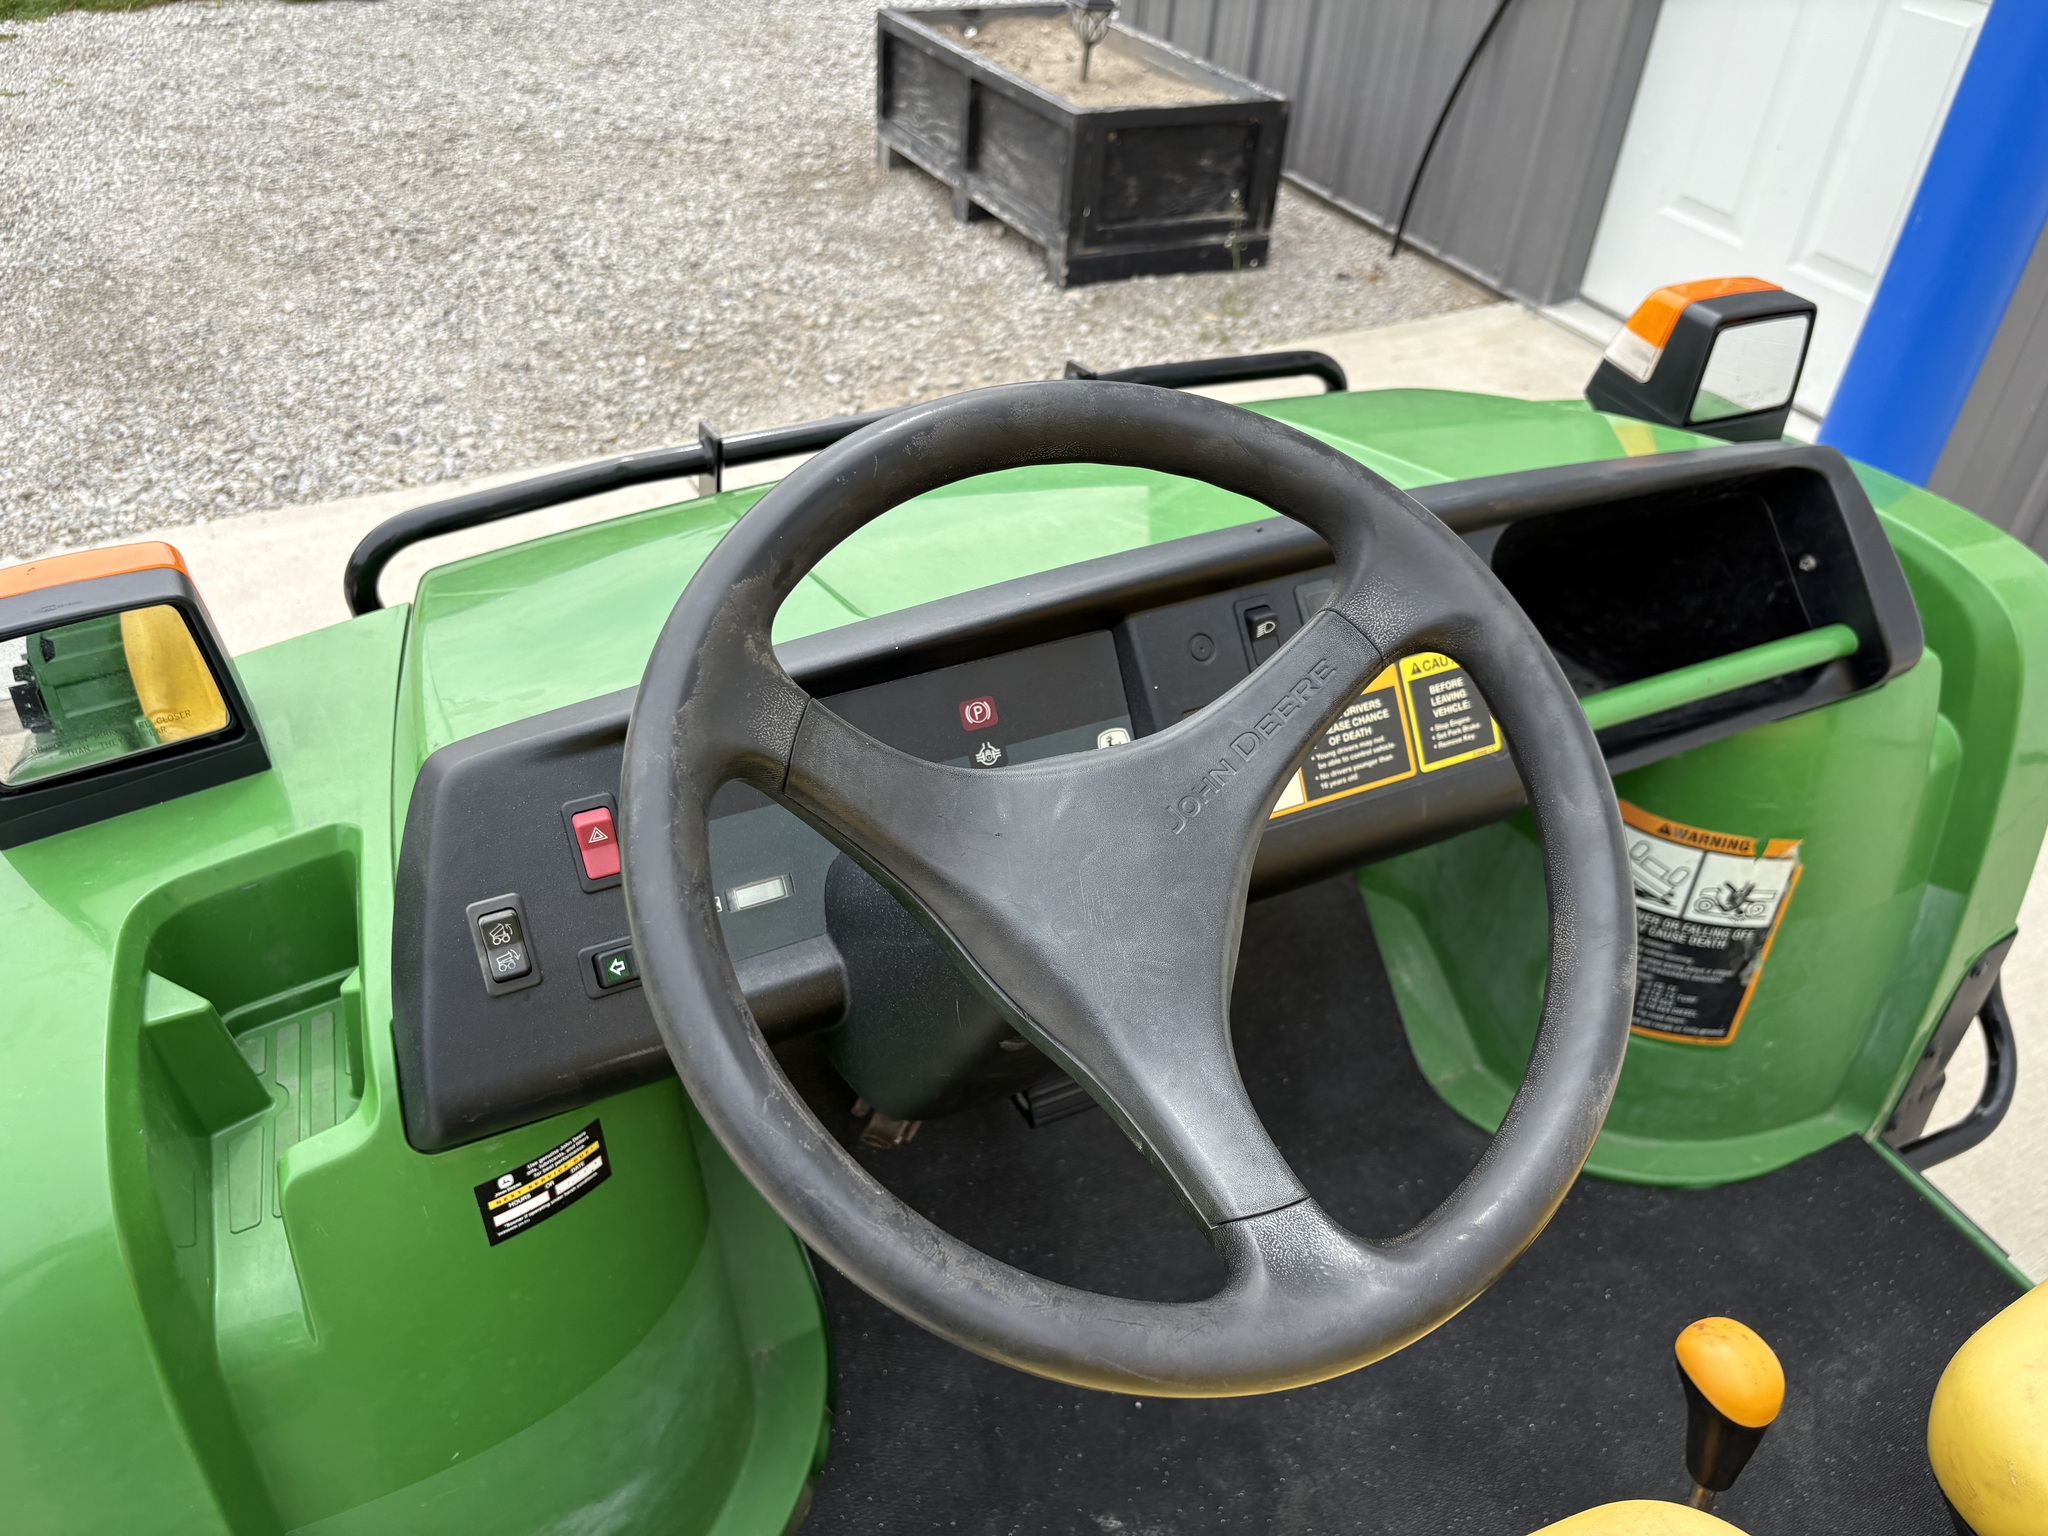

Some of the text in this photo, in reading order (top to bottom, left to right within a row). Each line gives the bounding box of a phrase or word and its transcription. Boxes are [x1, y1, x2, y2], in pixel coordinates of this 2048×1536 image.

[1428, 676, 1465, 695] BEFORE
[1343, 698, 1382, 717] DRIVERS
[1429, 688, 1468, 707] LEAVING
[1431, 699, 1472, 718] VEHICLE:
[156, 709, 192, 725] CLOSER
[1326, 708, 1390, 734] EASE CHANCE
[1434, 721, 1450, 732] Stop
[1328, 726, 1373, 746] OF DEATH
[1436, 722, 1481, 740] Set Park Brake
[67, 744, 91, 758] THAN
[99, 736, 124, 749] THEY
[1166, 658, 1337, 835] JOHN DEERE
[1316, 735, 1385, 761] Young drivers may not
[1438, 738, 1463, 750] Remove
[1318, 762, 1328, 770] be
[1328, 758, 1342, 768] able
[1341, 755, 1350, 763] to
[1350, 748, 1372, 760] control
[1319, 754, 1394, 780] No drivers younger than
[1329, 776, 1348, 788] years
[1674, 827, 1750, 851] WARNING
[1648, 925, 1687, 944] CAUSE
[1688, 934, 1728, 950] DEATH
[1662, 919, 1680, 930] OR
[1682, 922, 1732, 938] FALLING
[1732, 928, 1757, 941] OFF
[526, 1130, 587, 1170] Use genuine John Deere
[526, 1134, 590, 1176] oils, lubricants, and filters
[542, 1162, 555, 1174] best
[554, 1144, 586, 1168] performance.
[496, 1190, 522, 1205] NEXT
[528, 1164, 568, 1190] SERVICE
[508, 1161, 586, 1208] HOURS OR DATE
[528, 1202, 551, 1217] operating
[550, 1194, 564, 1205] under
[564, 1186, 577, 1197] harsh
